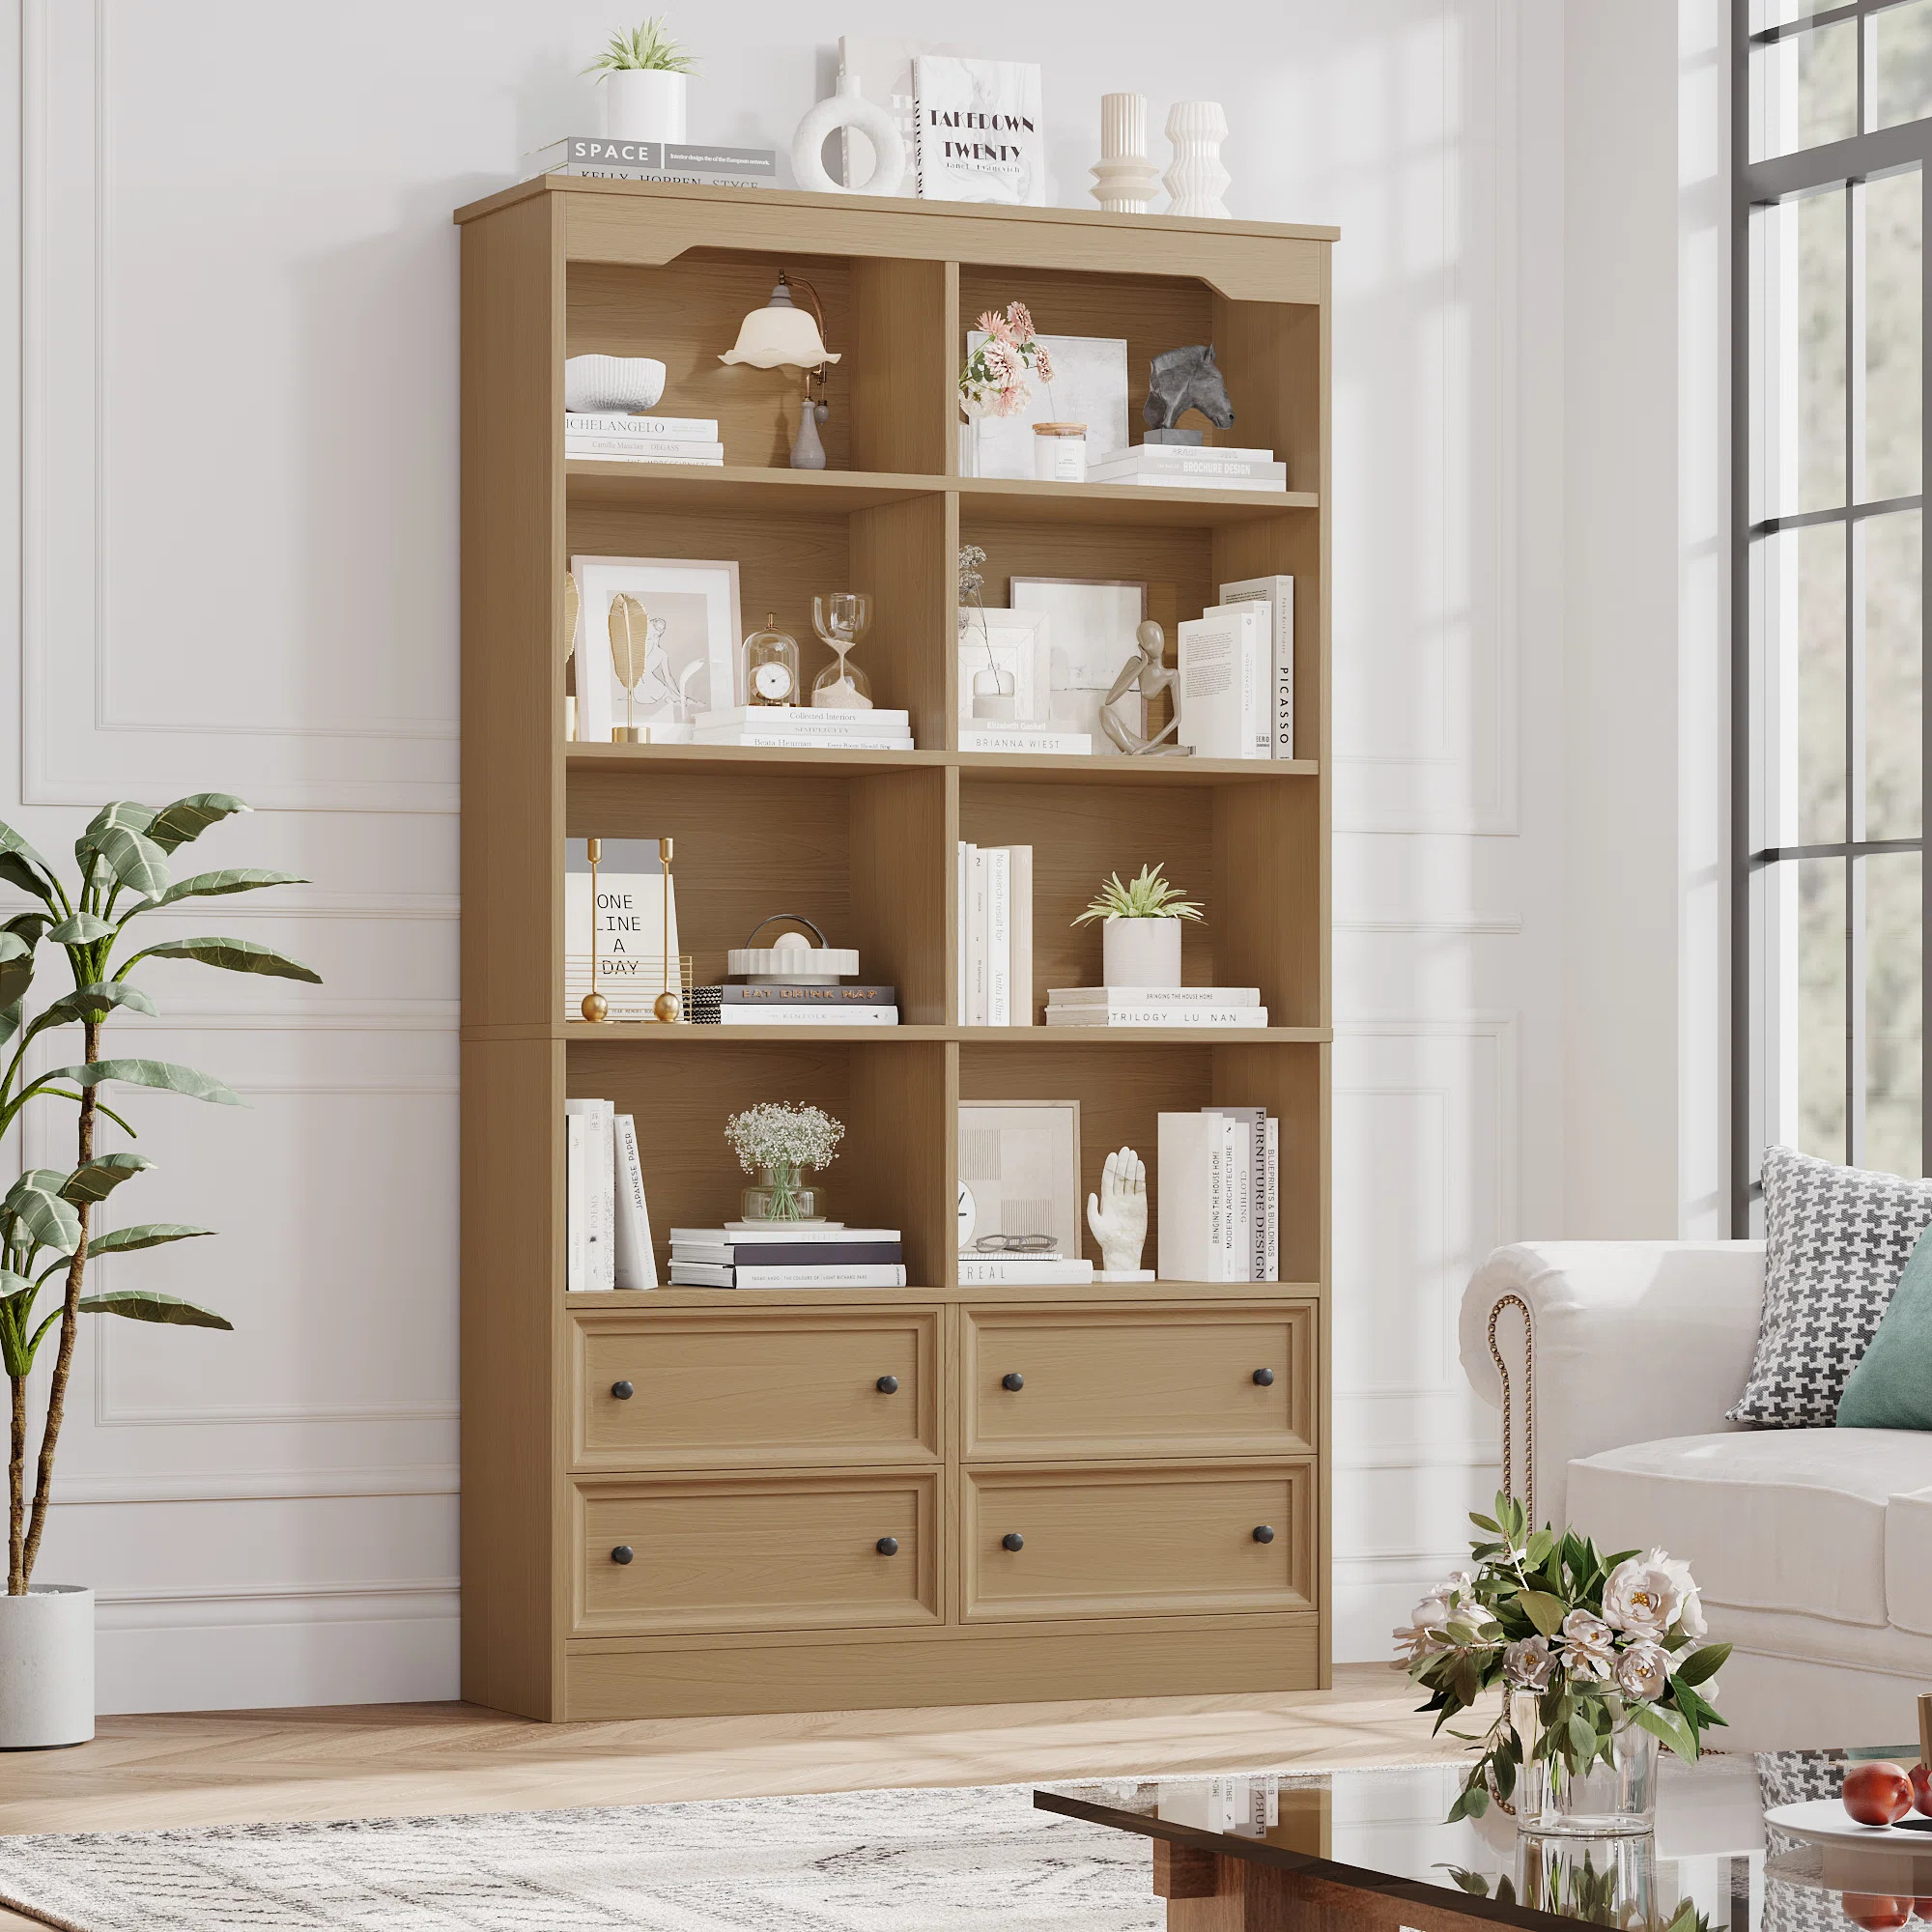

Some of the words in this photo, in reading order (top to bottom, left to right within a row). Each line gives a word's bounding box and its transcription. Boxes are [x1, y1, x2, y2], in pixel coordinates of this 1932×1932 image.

[928, 109, 1035, 133] TAKEDOWN
[575, 142, 648, 161] SPACE
[942, 140, 1023, 162] TWENTY
[566, 418, 665, 433] ICHELANGELO
[1183, 461, 1223, 474] BROCHURE
[1224, 463, 1251, 475] DESIGN
[1280, 668, 1290, 744] PICASSO
[789, 711, 823, 721] Collected
[826, 712, 856, 721] Interiors
[754, 738, 776, 747] Beata
[976, 738, 1024, 748] BRIANNA
[1029, 740, 1061, 749] WIEST
[996, 854, 1004, 867] No
[995, 869, 1005, 899] search
[597, 894, 634, 910] ONE
[995, 901, 1004, 927] result
[995, 929, 1004, 941] for
[613, 938, 626, 953] A
[602, 959, 639, 975] DAY
[742, 988, 772, 999] EAT
[780, 988, 835, 999] DRINK
[841, 988, 878, 1000] NAP
[1112, 1012, 1168, 1022] TRILOGY
[1184, 1013, 1200, 1022] LU
[1210, 1013, 1237, 1022] NAN
[625, 1132, 635, 1161] PAPER
[1256, 1111, 1264, 1211] FURNITURE
[630, 1164, 643, 1208] JAPANESE
[1256, 1217, 1264, 1280] DESIGN
